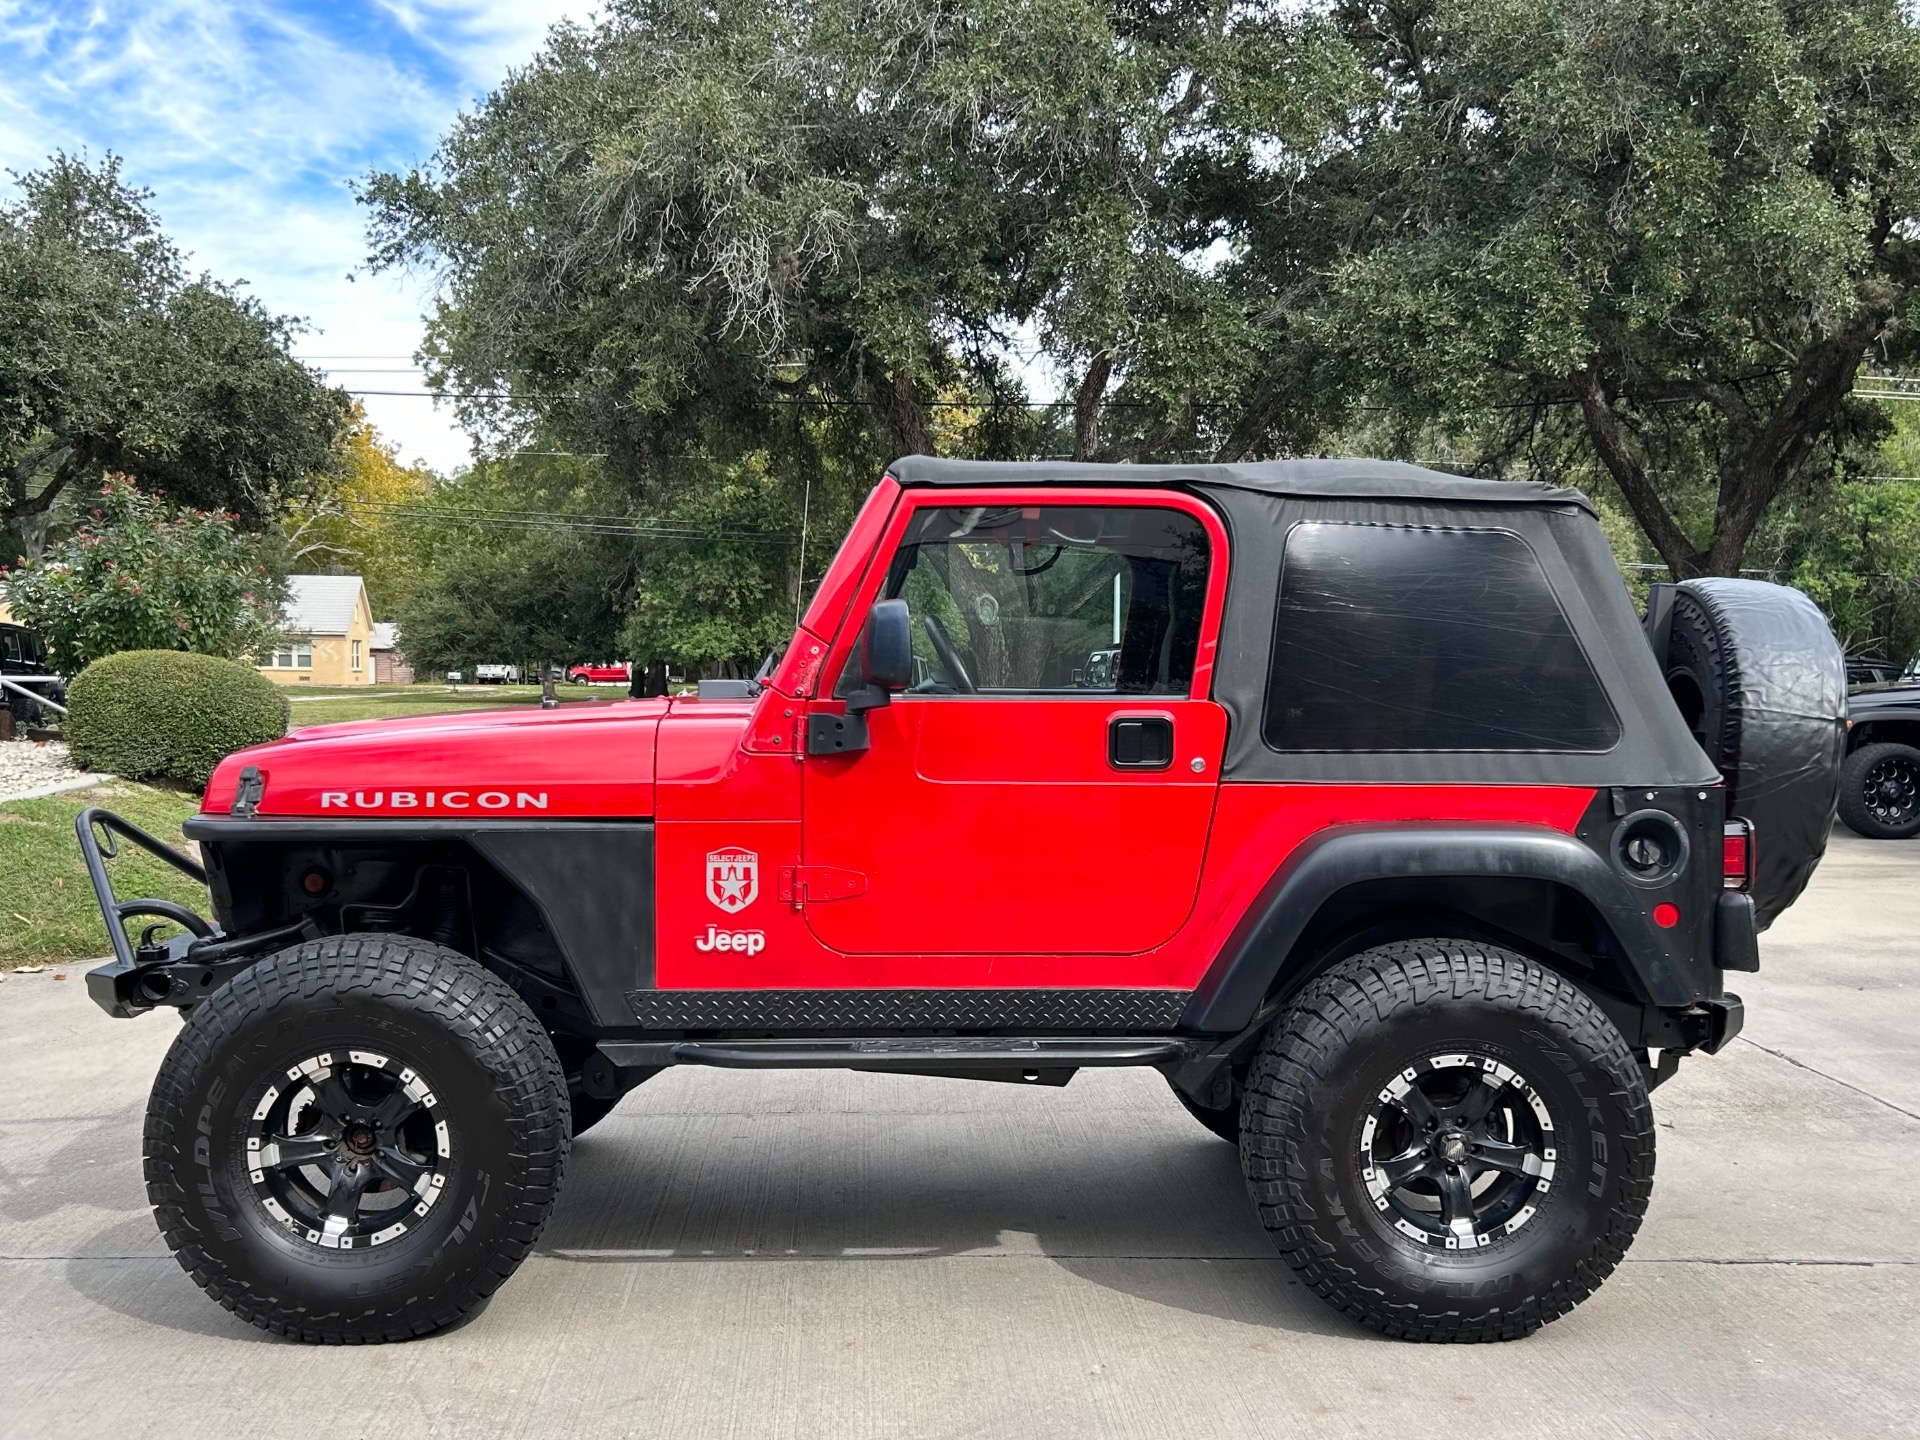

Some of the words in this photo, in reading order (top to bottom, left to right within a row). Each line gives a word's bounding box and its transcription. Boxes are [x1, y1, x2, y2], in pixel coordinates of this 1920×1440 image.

[321, 791, 548, 809] RUBICON
[709, 854, 734, 862] SELECT
[734, 854, 756, 862] JEEPS
[695, 926, 766, 957] Jeep
[1519, 1029, 1609, 1198] FALKEN
[1323, 1190, 1513, 1298] WILDPEAK
